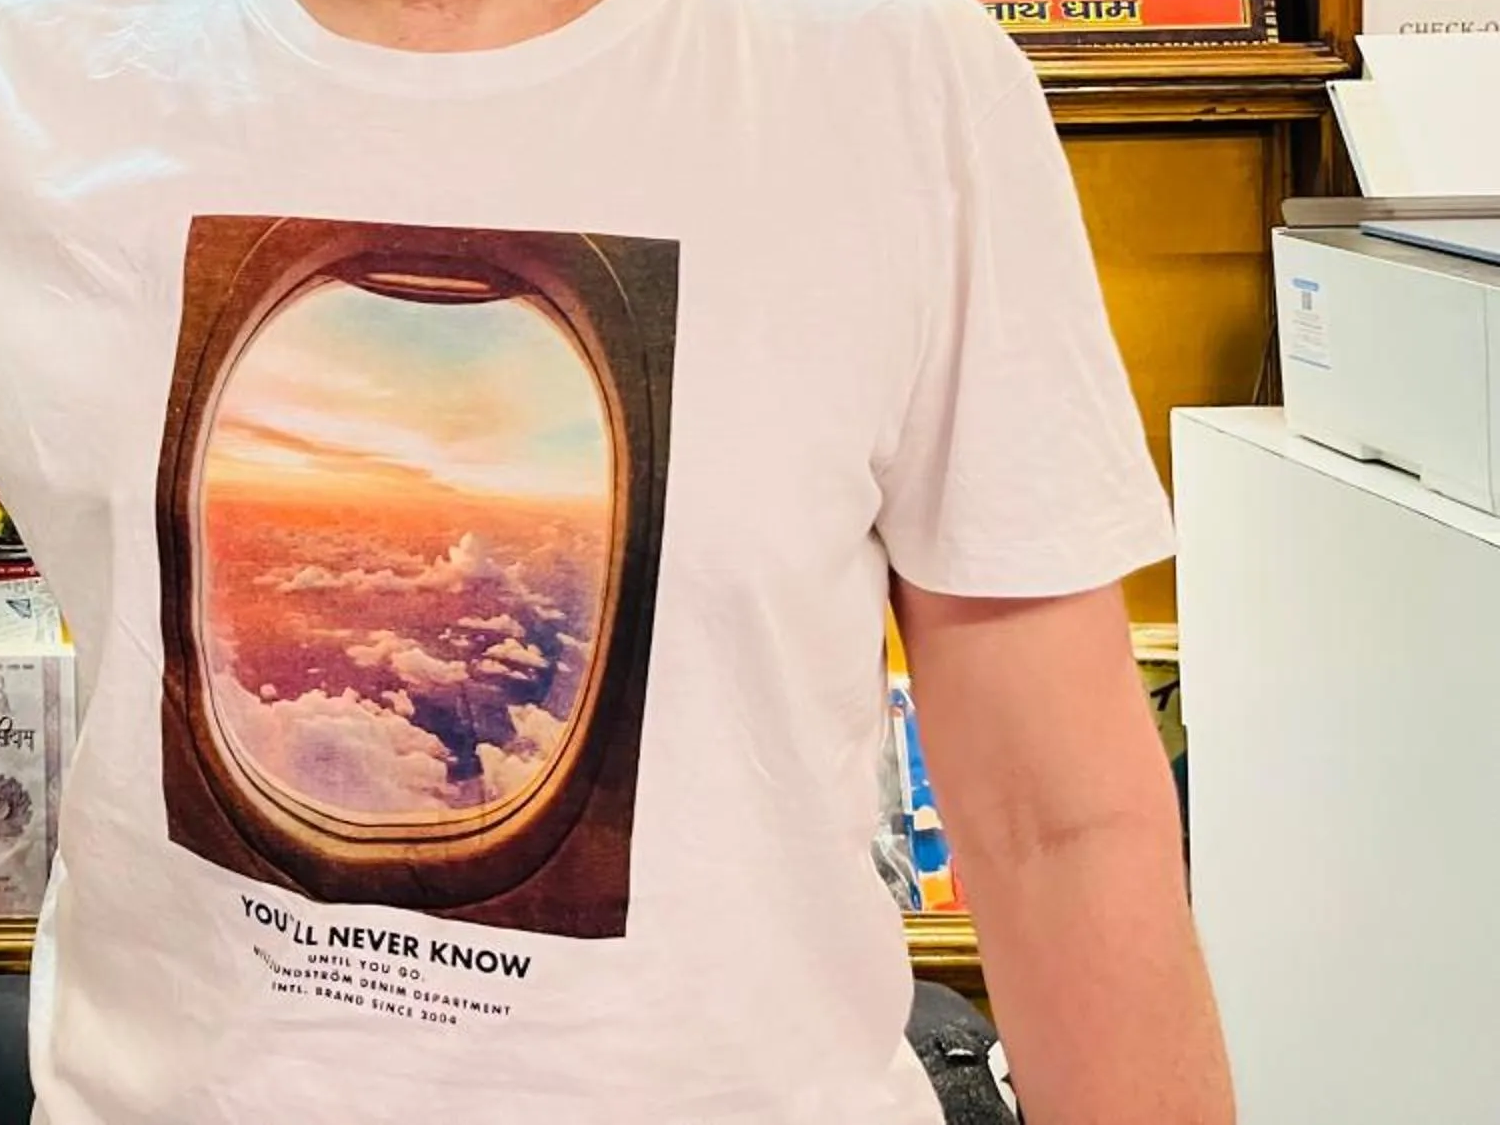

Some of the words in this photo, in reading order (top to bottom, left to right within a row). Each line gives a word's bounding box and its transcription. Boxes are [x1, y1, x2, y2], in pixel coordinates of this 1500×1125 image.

[241, 894, 319, 946] YOU'LL
[328, 925, 419, 960] NEVER
[430, 940, 532, 979] KNOW
[308, 954, 352, 968] UNTIL
[359, 959, 391, 974] YOU
[315, 986, 365, 1006] BRAND
[371, 998, 413, 1018] SINCE
[359, 978, 407, 997] DENIM
[412, 989, 512, 1017] DEPARTMENT
